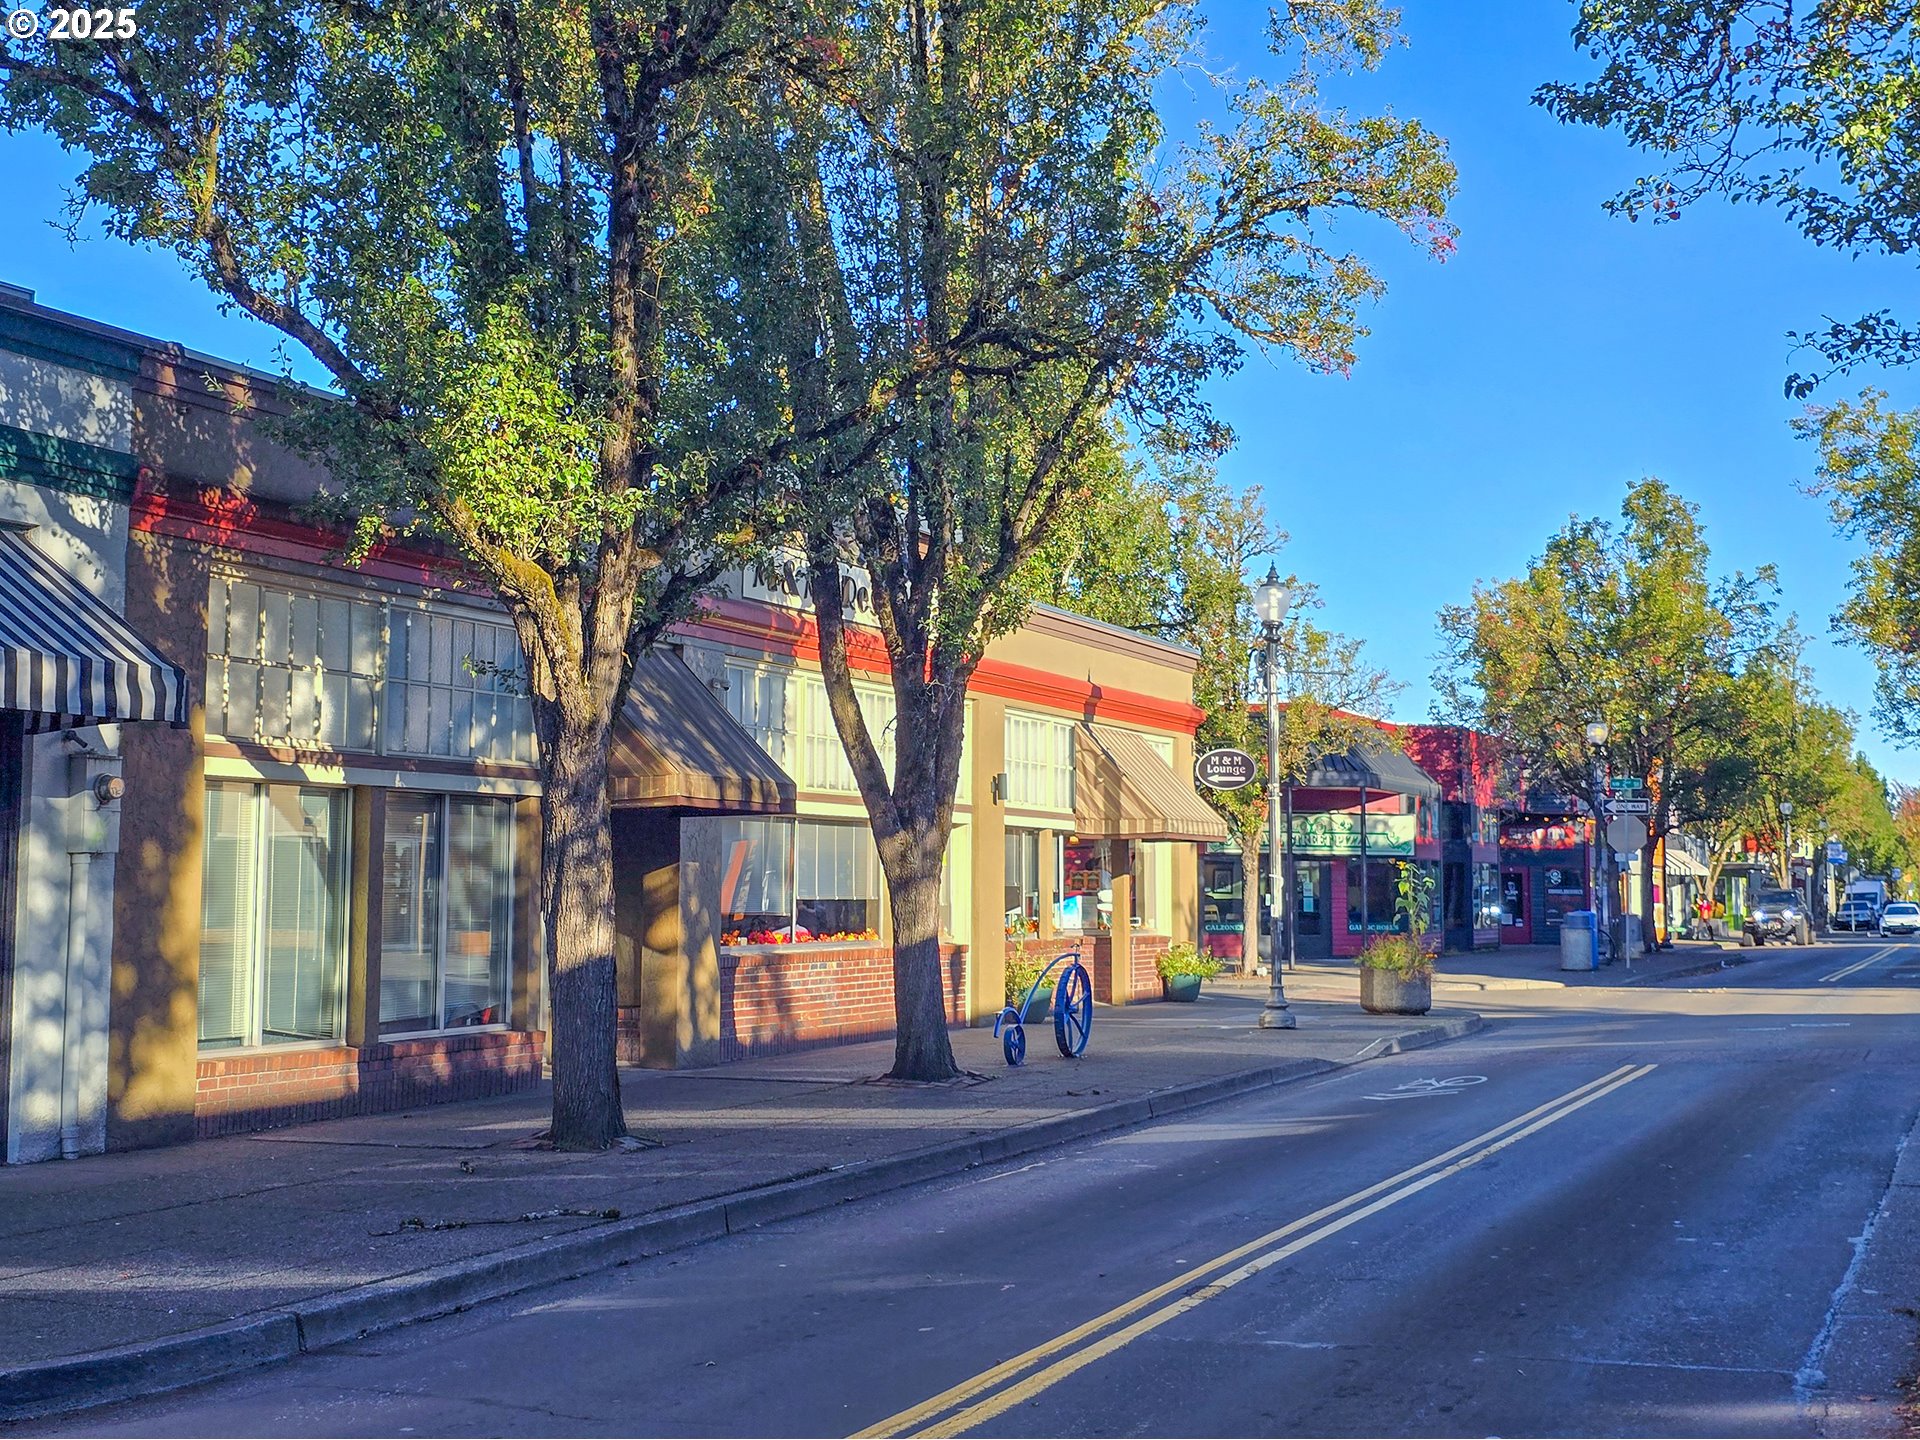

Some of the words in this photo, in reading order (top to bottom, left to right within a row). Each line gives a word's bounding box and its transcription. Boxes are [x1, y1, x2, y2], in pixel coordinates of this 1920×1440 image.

[1210, 756, 1219, 765] M
[1222, 756, 1231, 765] &
[1233, 756, 1242, 765] M
[1206, 764, 1246, 776] Lounge
